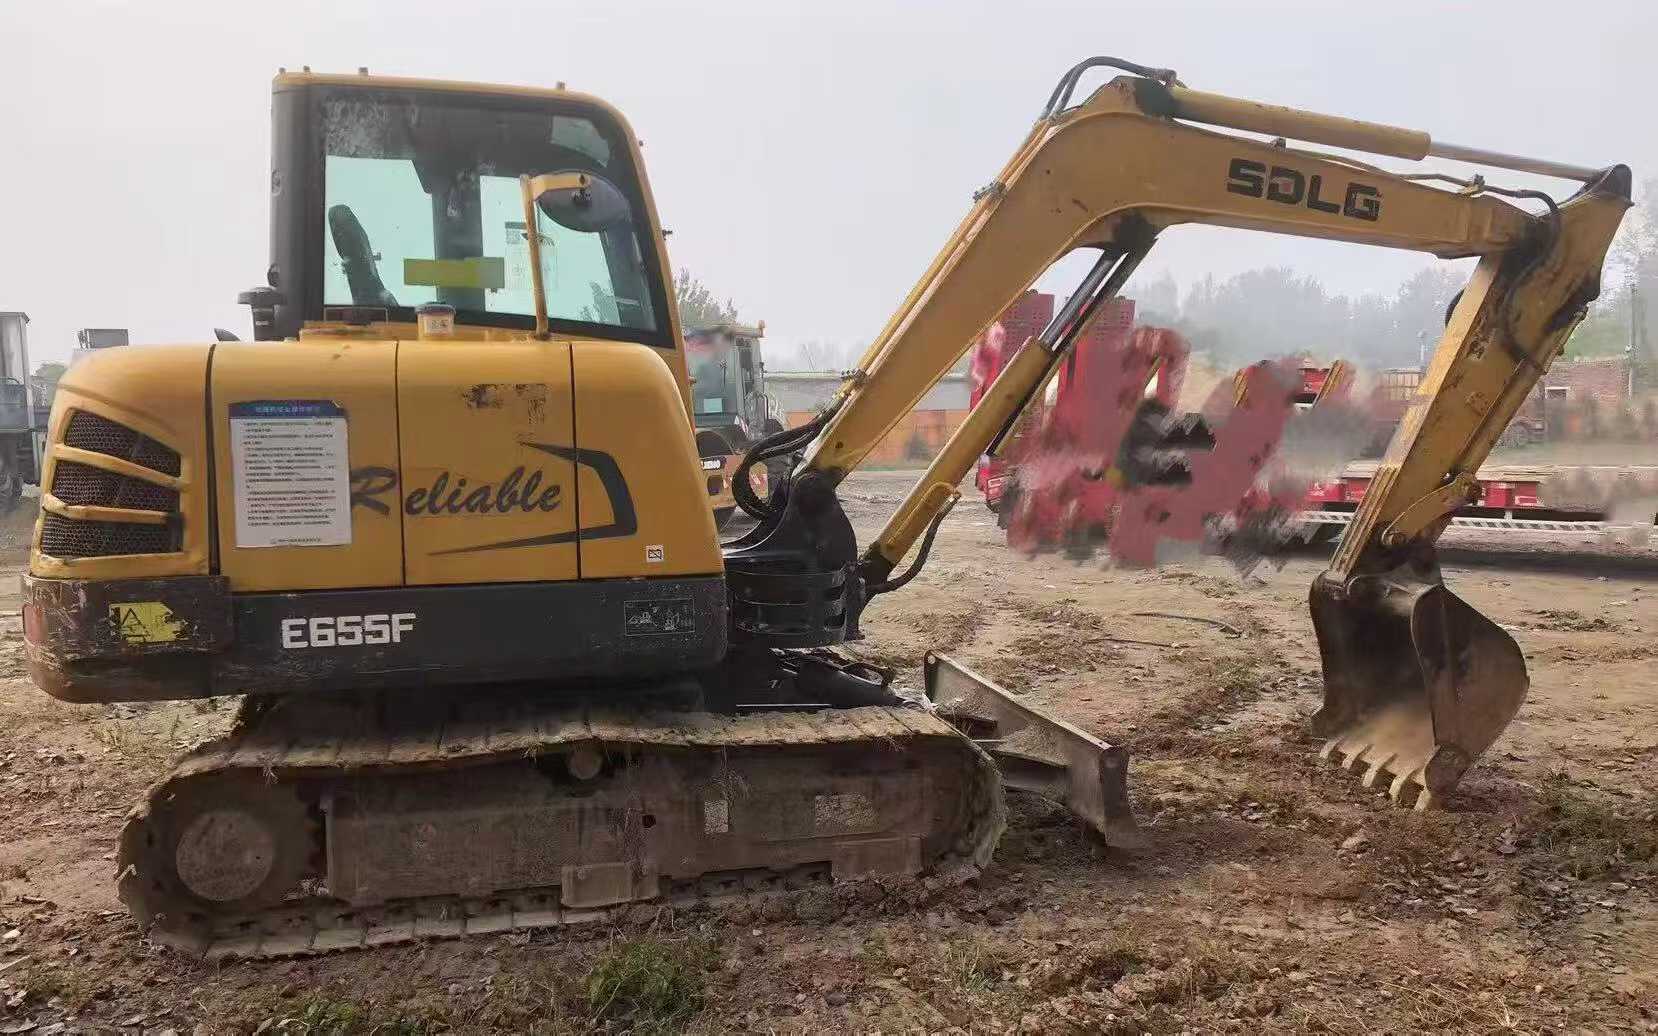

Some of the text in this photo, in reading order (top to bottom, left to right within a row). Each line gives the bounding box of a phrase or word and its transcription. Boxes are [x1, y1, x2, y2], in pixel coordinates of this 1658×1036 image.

[1227, 158, 1381, 221] SDLG
[350, 466, 561, 515] Reliable
[281, 613, 417, 649] E655F
